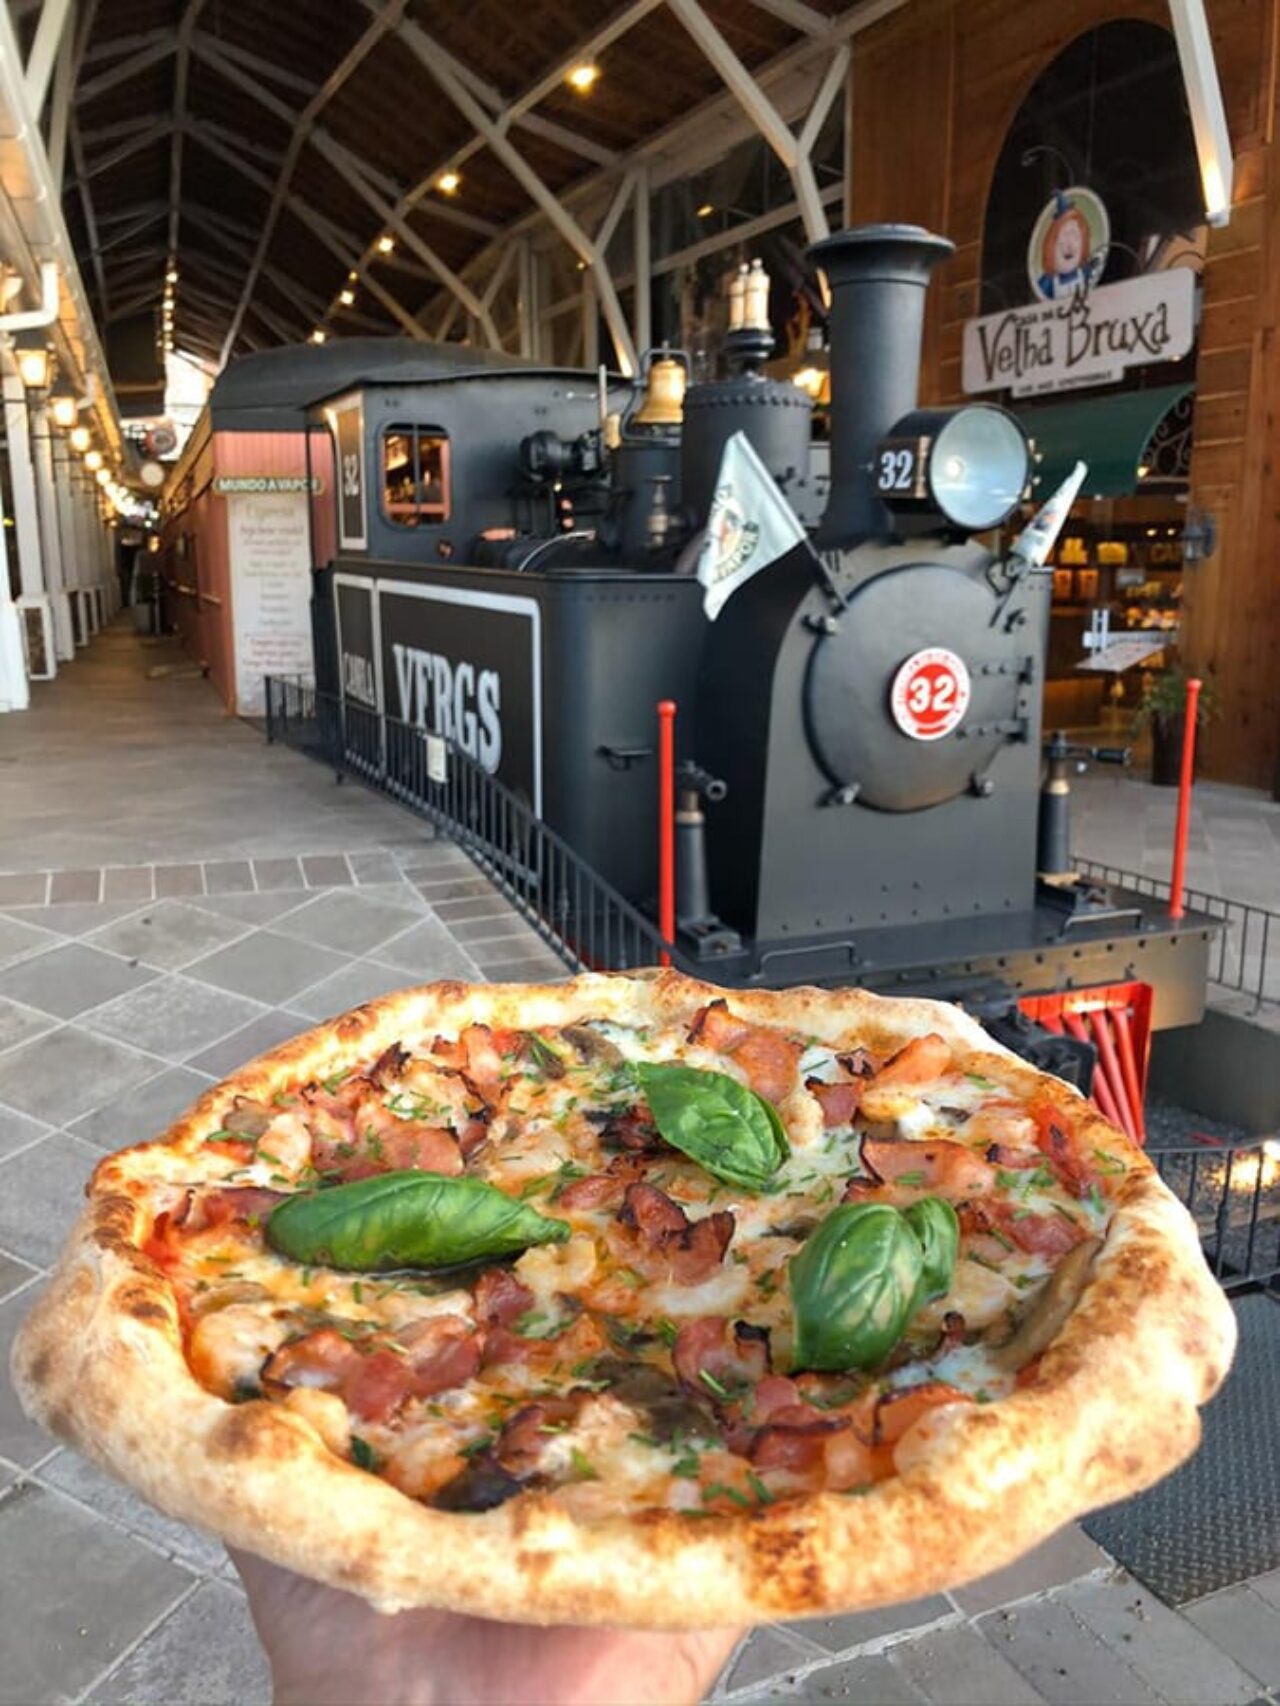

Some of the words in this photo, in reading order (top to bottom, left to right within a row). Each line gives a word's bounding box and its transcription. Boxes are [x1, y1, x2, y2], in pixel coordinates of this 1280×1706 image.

[977, 314, 1054, 382] Velha
[1065, 303, 1171, 368] Bruxa
[878, 450, 913, 490] 32
[392, 643, 502, 775] VFRGS
[908, 673, 958, 714] 32
